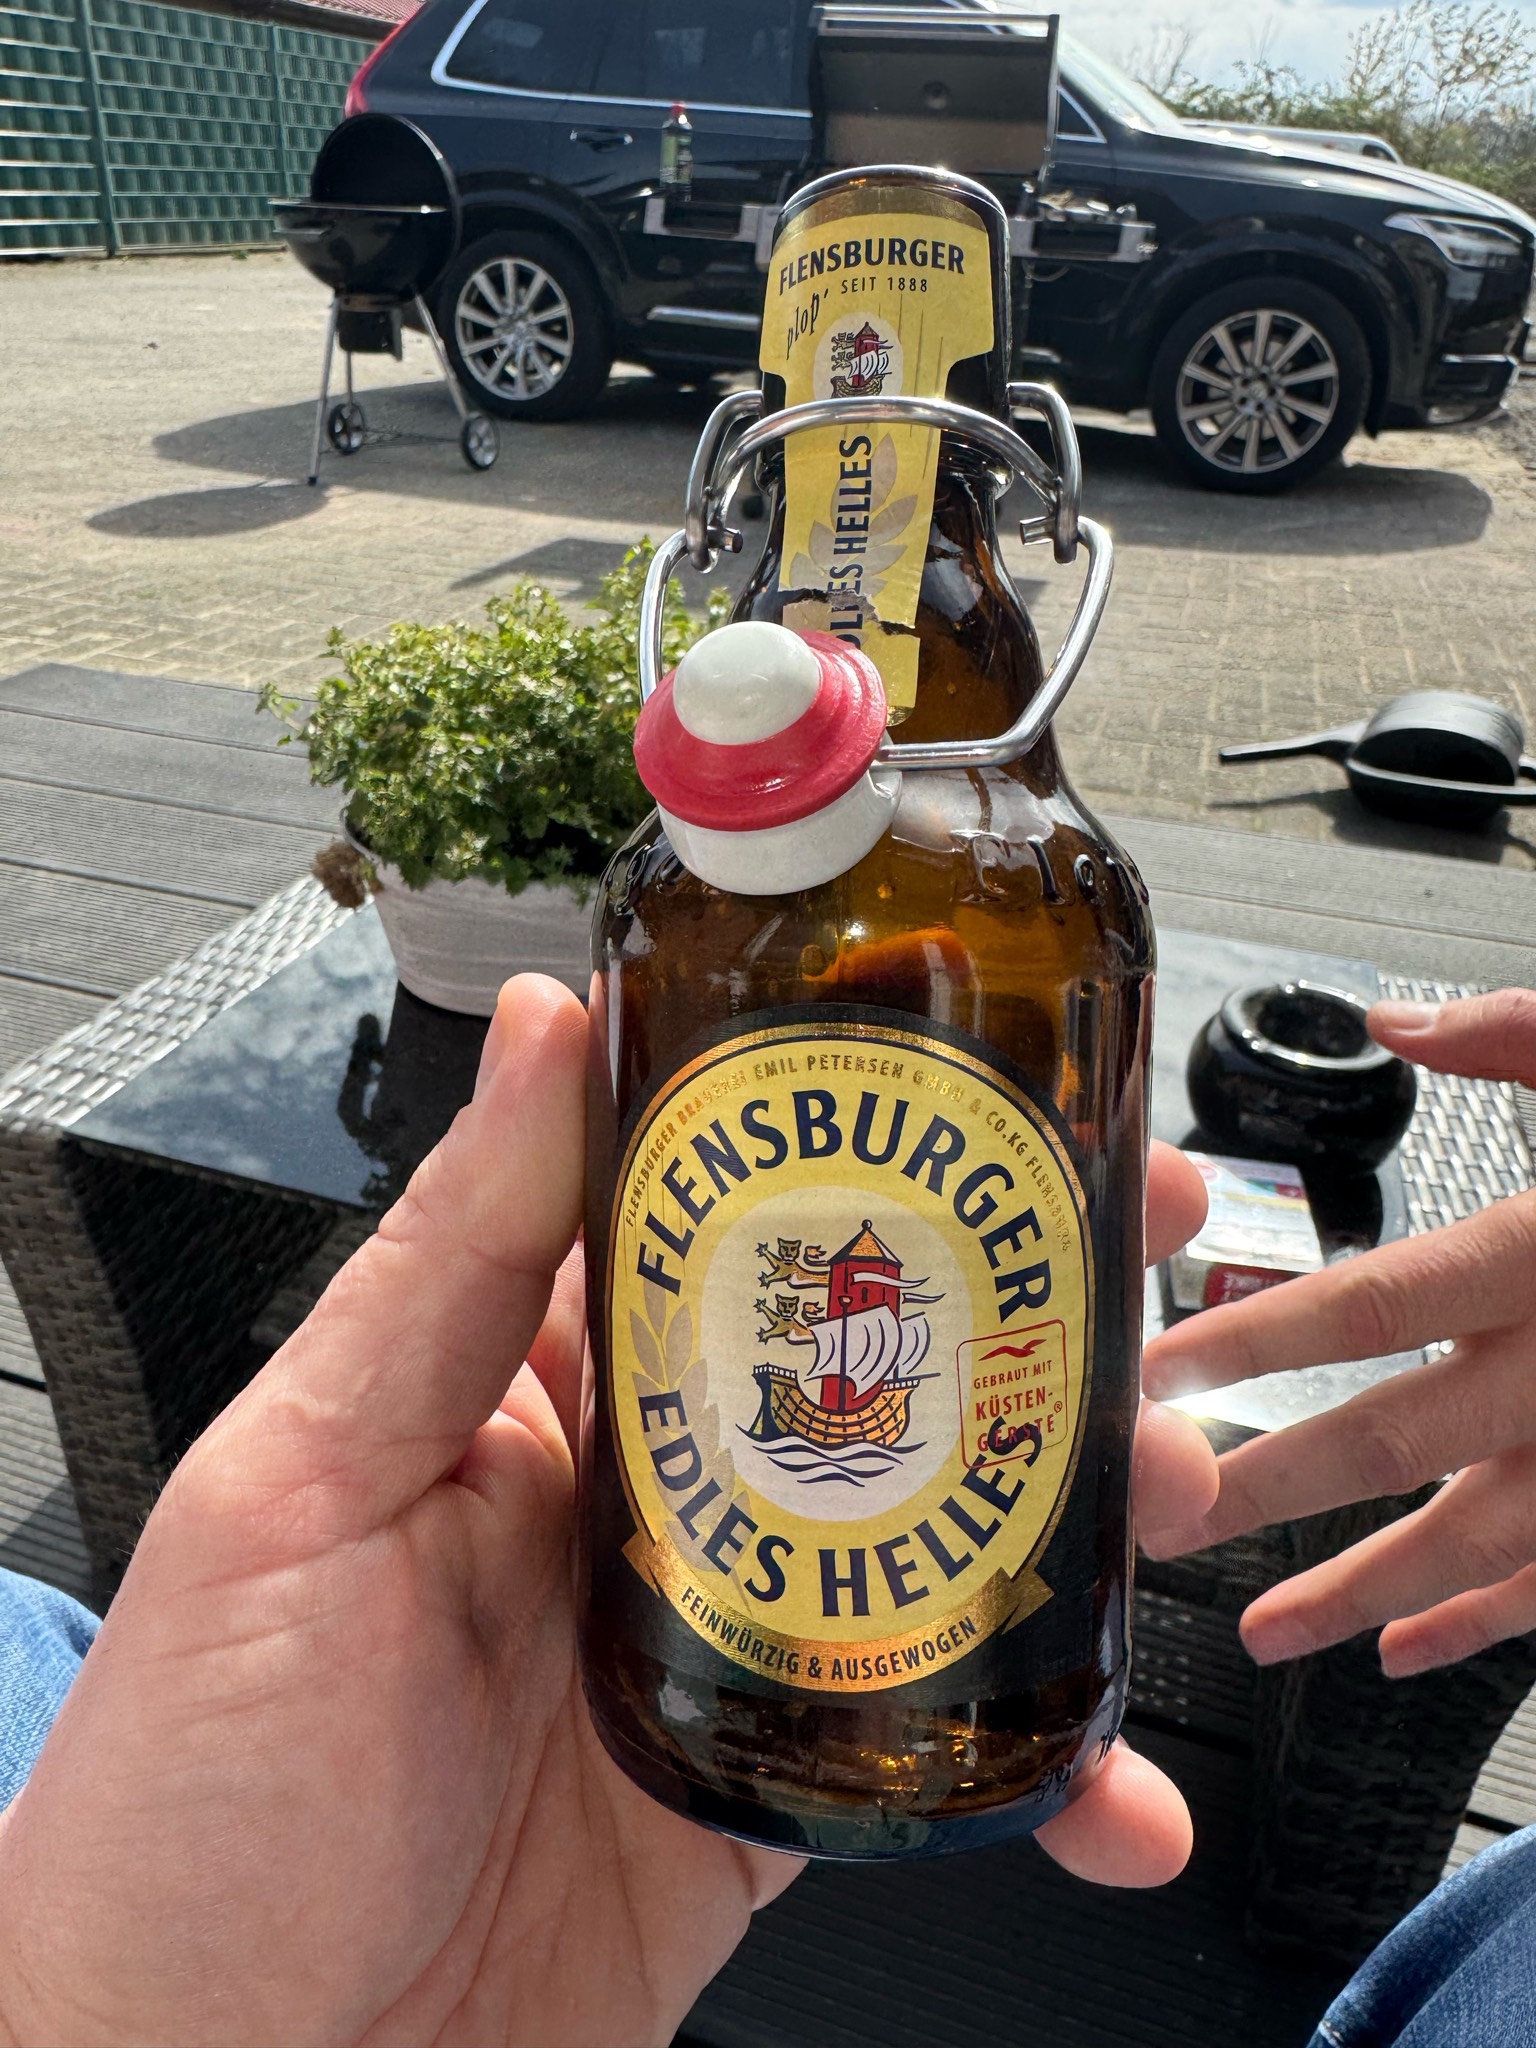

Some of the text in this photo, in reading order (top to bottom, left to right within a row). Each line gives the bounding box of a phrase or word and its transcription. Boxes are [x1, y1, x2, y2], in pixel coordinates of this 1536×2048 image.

[779, 238, 965, 296] FLENSBURGER
[841, 277, 928, 294] SEIT 1888
[833, 435, 872, 554] HELLES
[625, 1122, 678, 1228] FLENSBURGER
[754, 1057, 798, 1080] EMIL
[807, 1054, 904, 1079] PETERSEN
[637, 1089, 1053, 1324] FLENSBURGER
[973, 1360, 1052, 1389] GEBRAUT MIT
[976, 1386, 1053, 1421] KÜSTEN-
[638, 1390, 1043, 1617] EDLES HELLES
[681, 1586, 977, 1680] FEINWÜRZIG & AUSGEWOGEN
